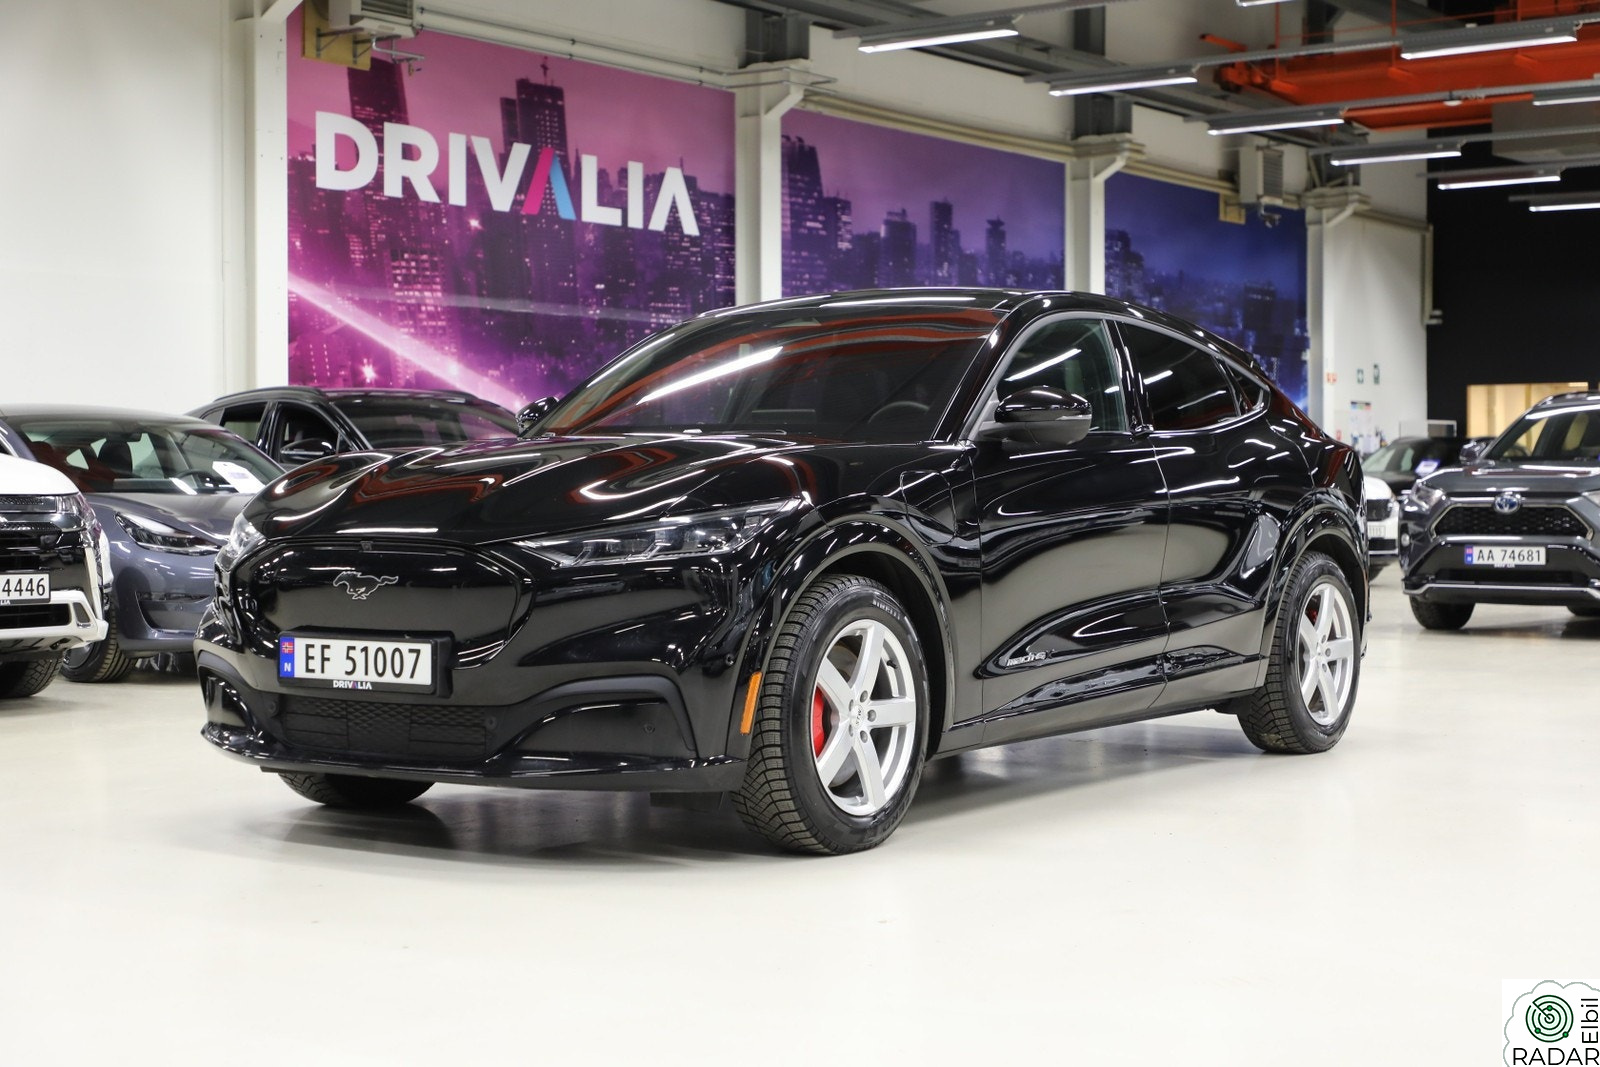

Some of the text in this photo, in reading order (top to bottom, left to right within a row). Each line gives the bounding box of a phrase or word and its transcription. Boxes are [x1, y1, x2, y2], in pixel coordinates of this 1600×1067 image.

[315, 110, 700, 236] DRIVALIA
[1478, 549, 1494, 561] AA
[1501, 549, 1540, 562] 74681
[2, 577, 45, 596] 4446
[284, 662, 292, 673] N
[305, 643, 421, 679] EF 51007
[333, 679, 373, 691] DRIVALIA
